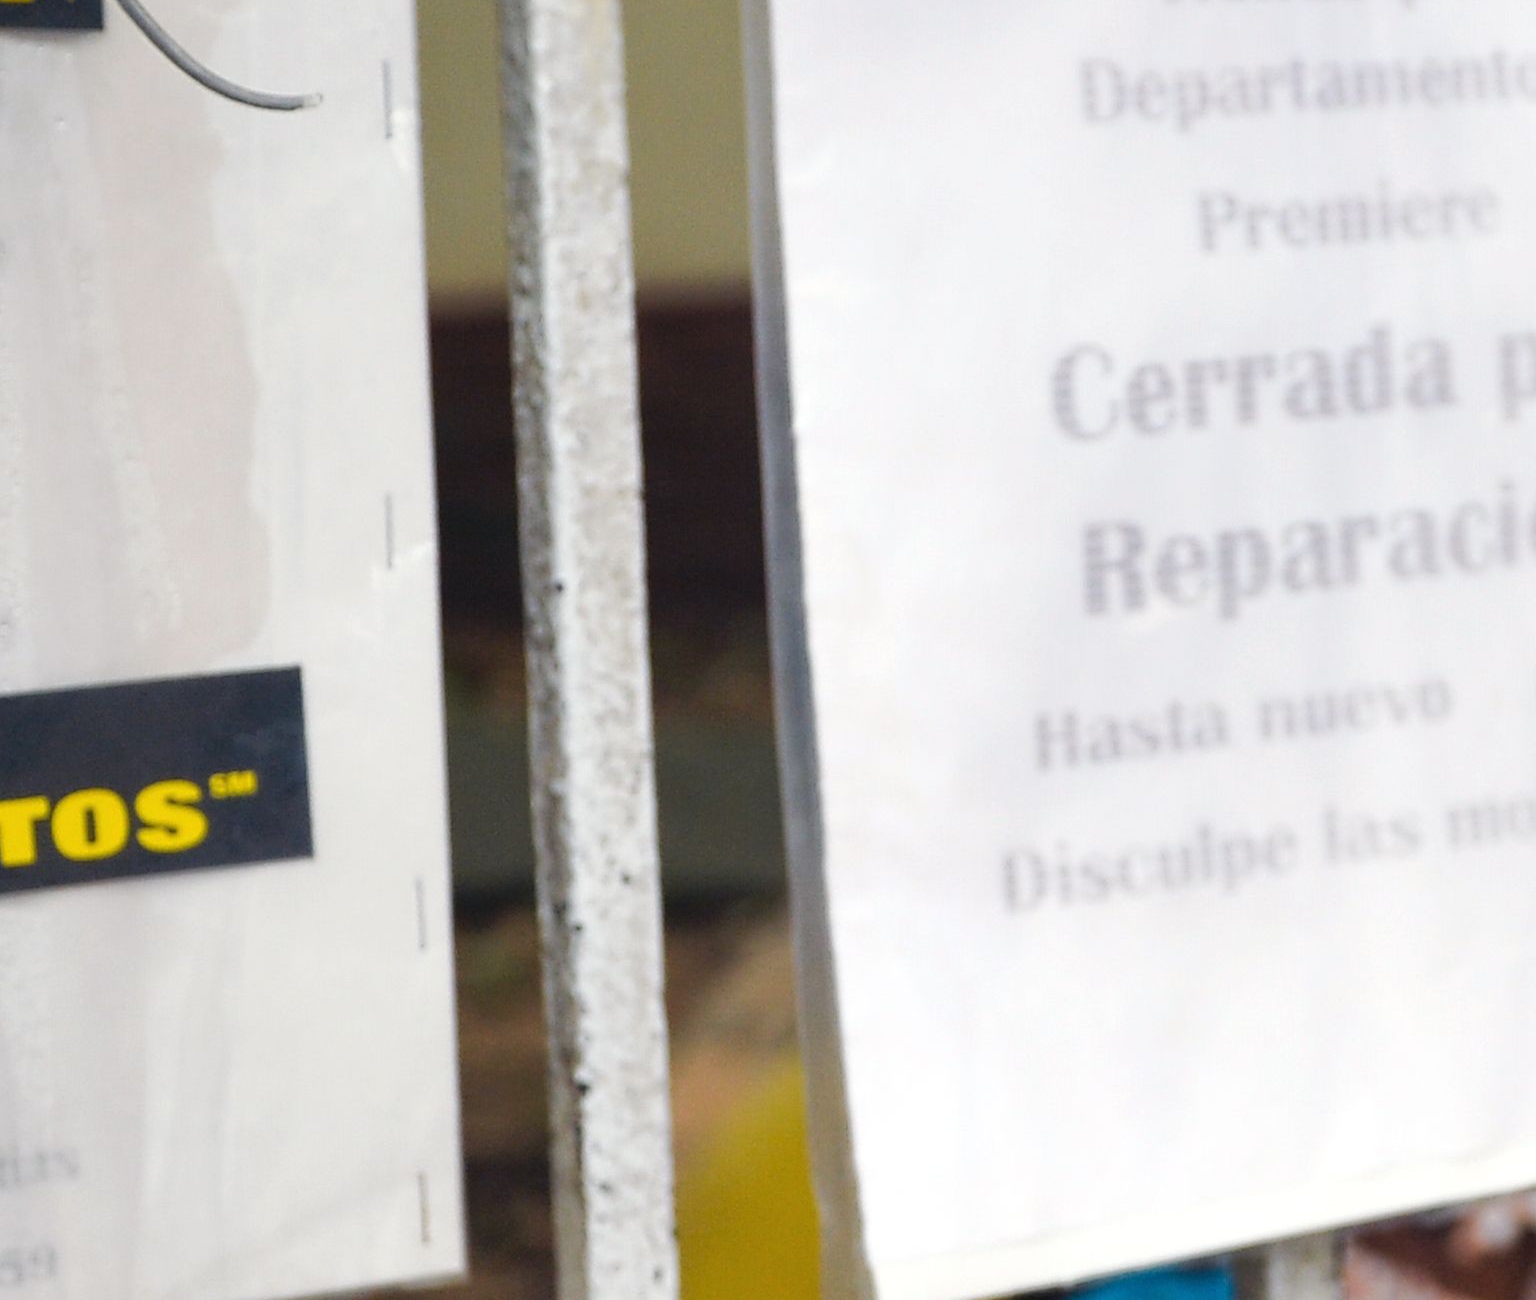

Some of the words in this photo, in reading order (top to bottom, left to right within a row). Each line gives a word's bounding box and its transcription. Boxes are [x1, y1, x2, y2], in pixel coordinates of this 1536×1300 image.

[1194, 182, 1501, 256] Premiere
[1048, 324, 1456, 443] Cerrada
[1031, 700, 1231, 775] Hasta
[1256, 674, 1454, 743] nuevo
[996, 822, 1299, 916] Disculpe
[1320, 804, 1424, 867] las
